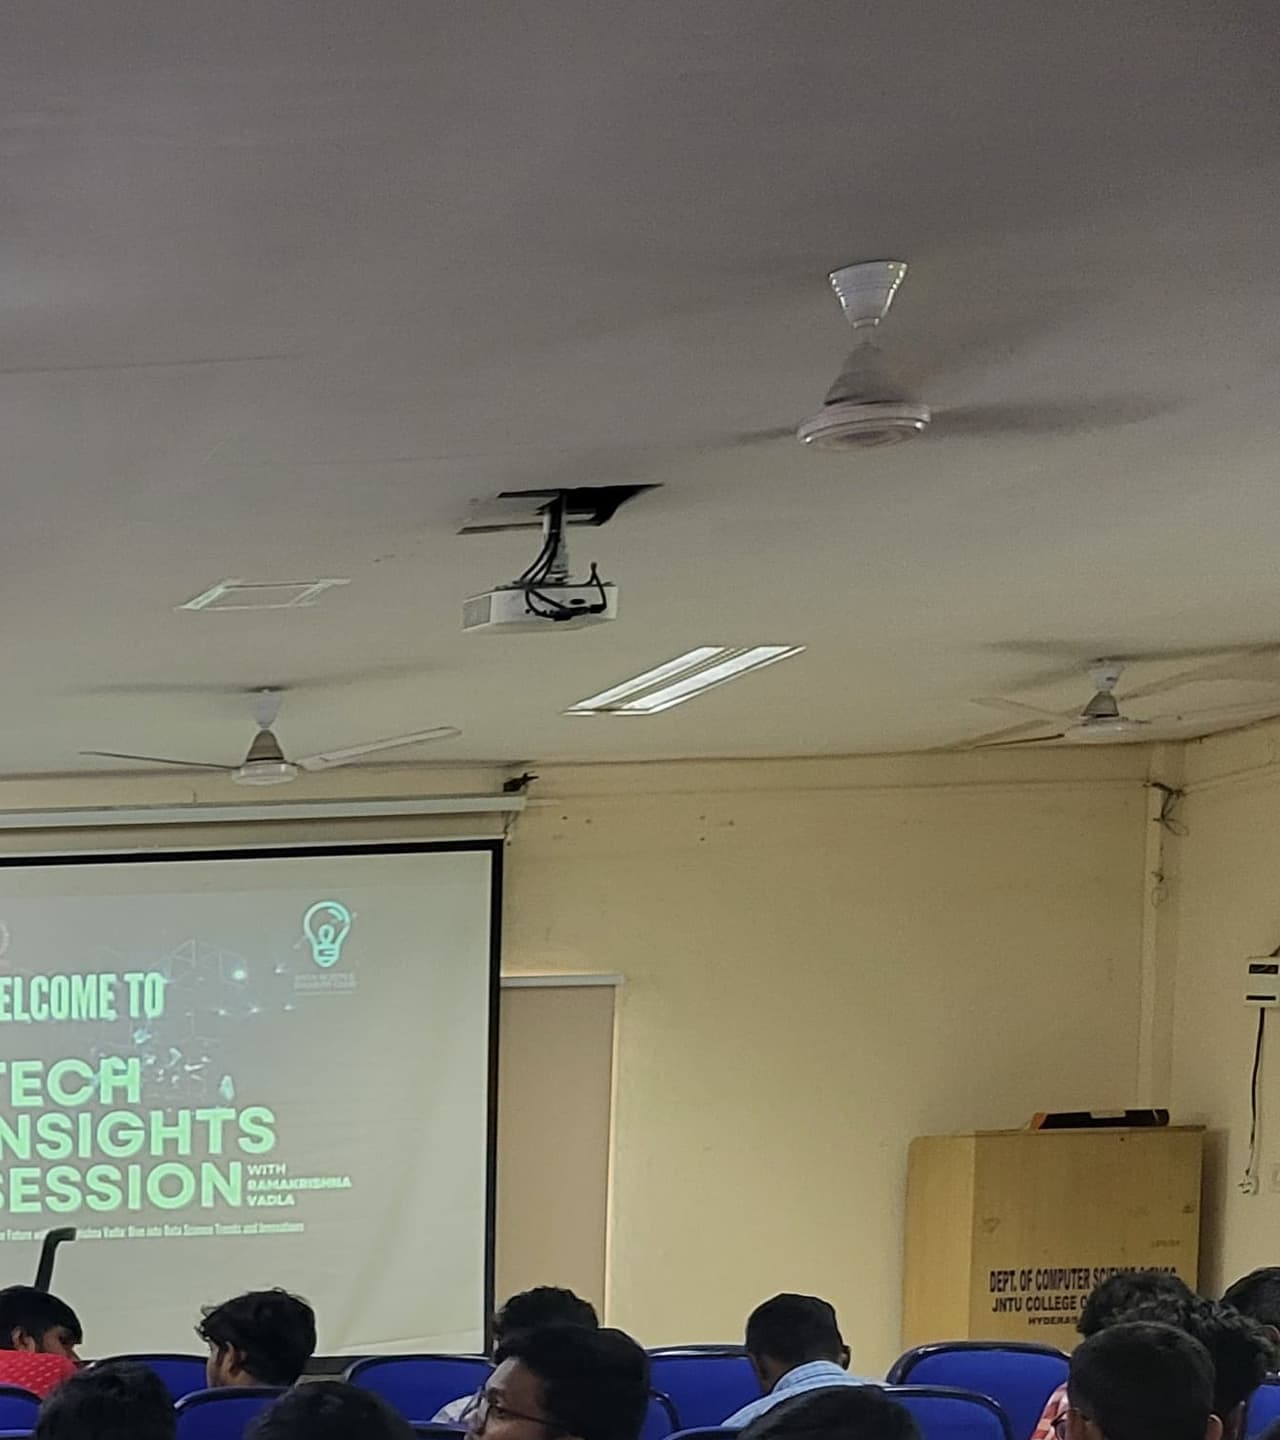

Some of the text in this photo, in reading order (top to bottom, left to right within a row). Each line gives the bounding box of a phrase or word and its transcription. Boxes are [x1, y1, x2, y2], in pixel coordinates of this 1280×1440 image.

[124, 971, 165, 1018] TO
[247, 1163, 287, 1176] WITH
[247, 1193, 295, 1207] VADLA
[990, 1270, 1017, 1293] DEPT.
[1019, 1269, 1033, 1291] OF
[1035, 1267, 1090, 1290] COMPUTER
[992, 1297, 1022, 1313] JNTU
[1026, 1295, 1077, 1312] COLLEGE
